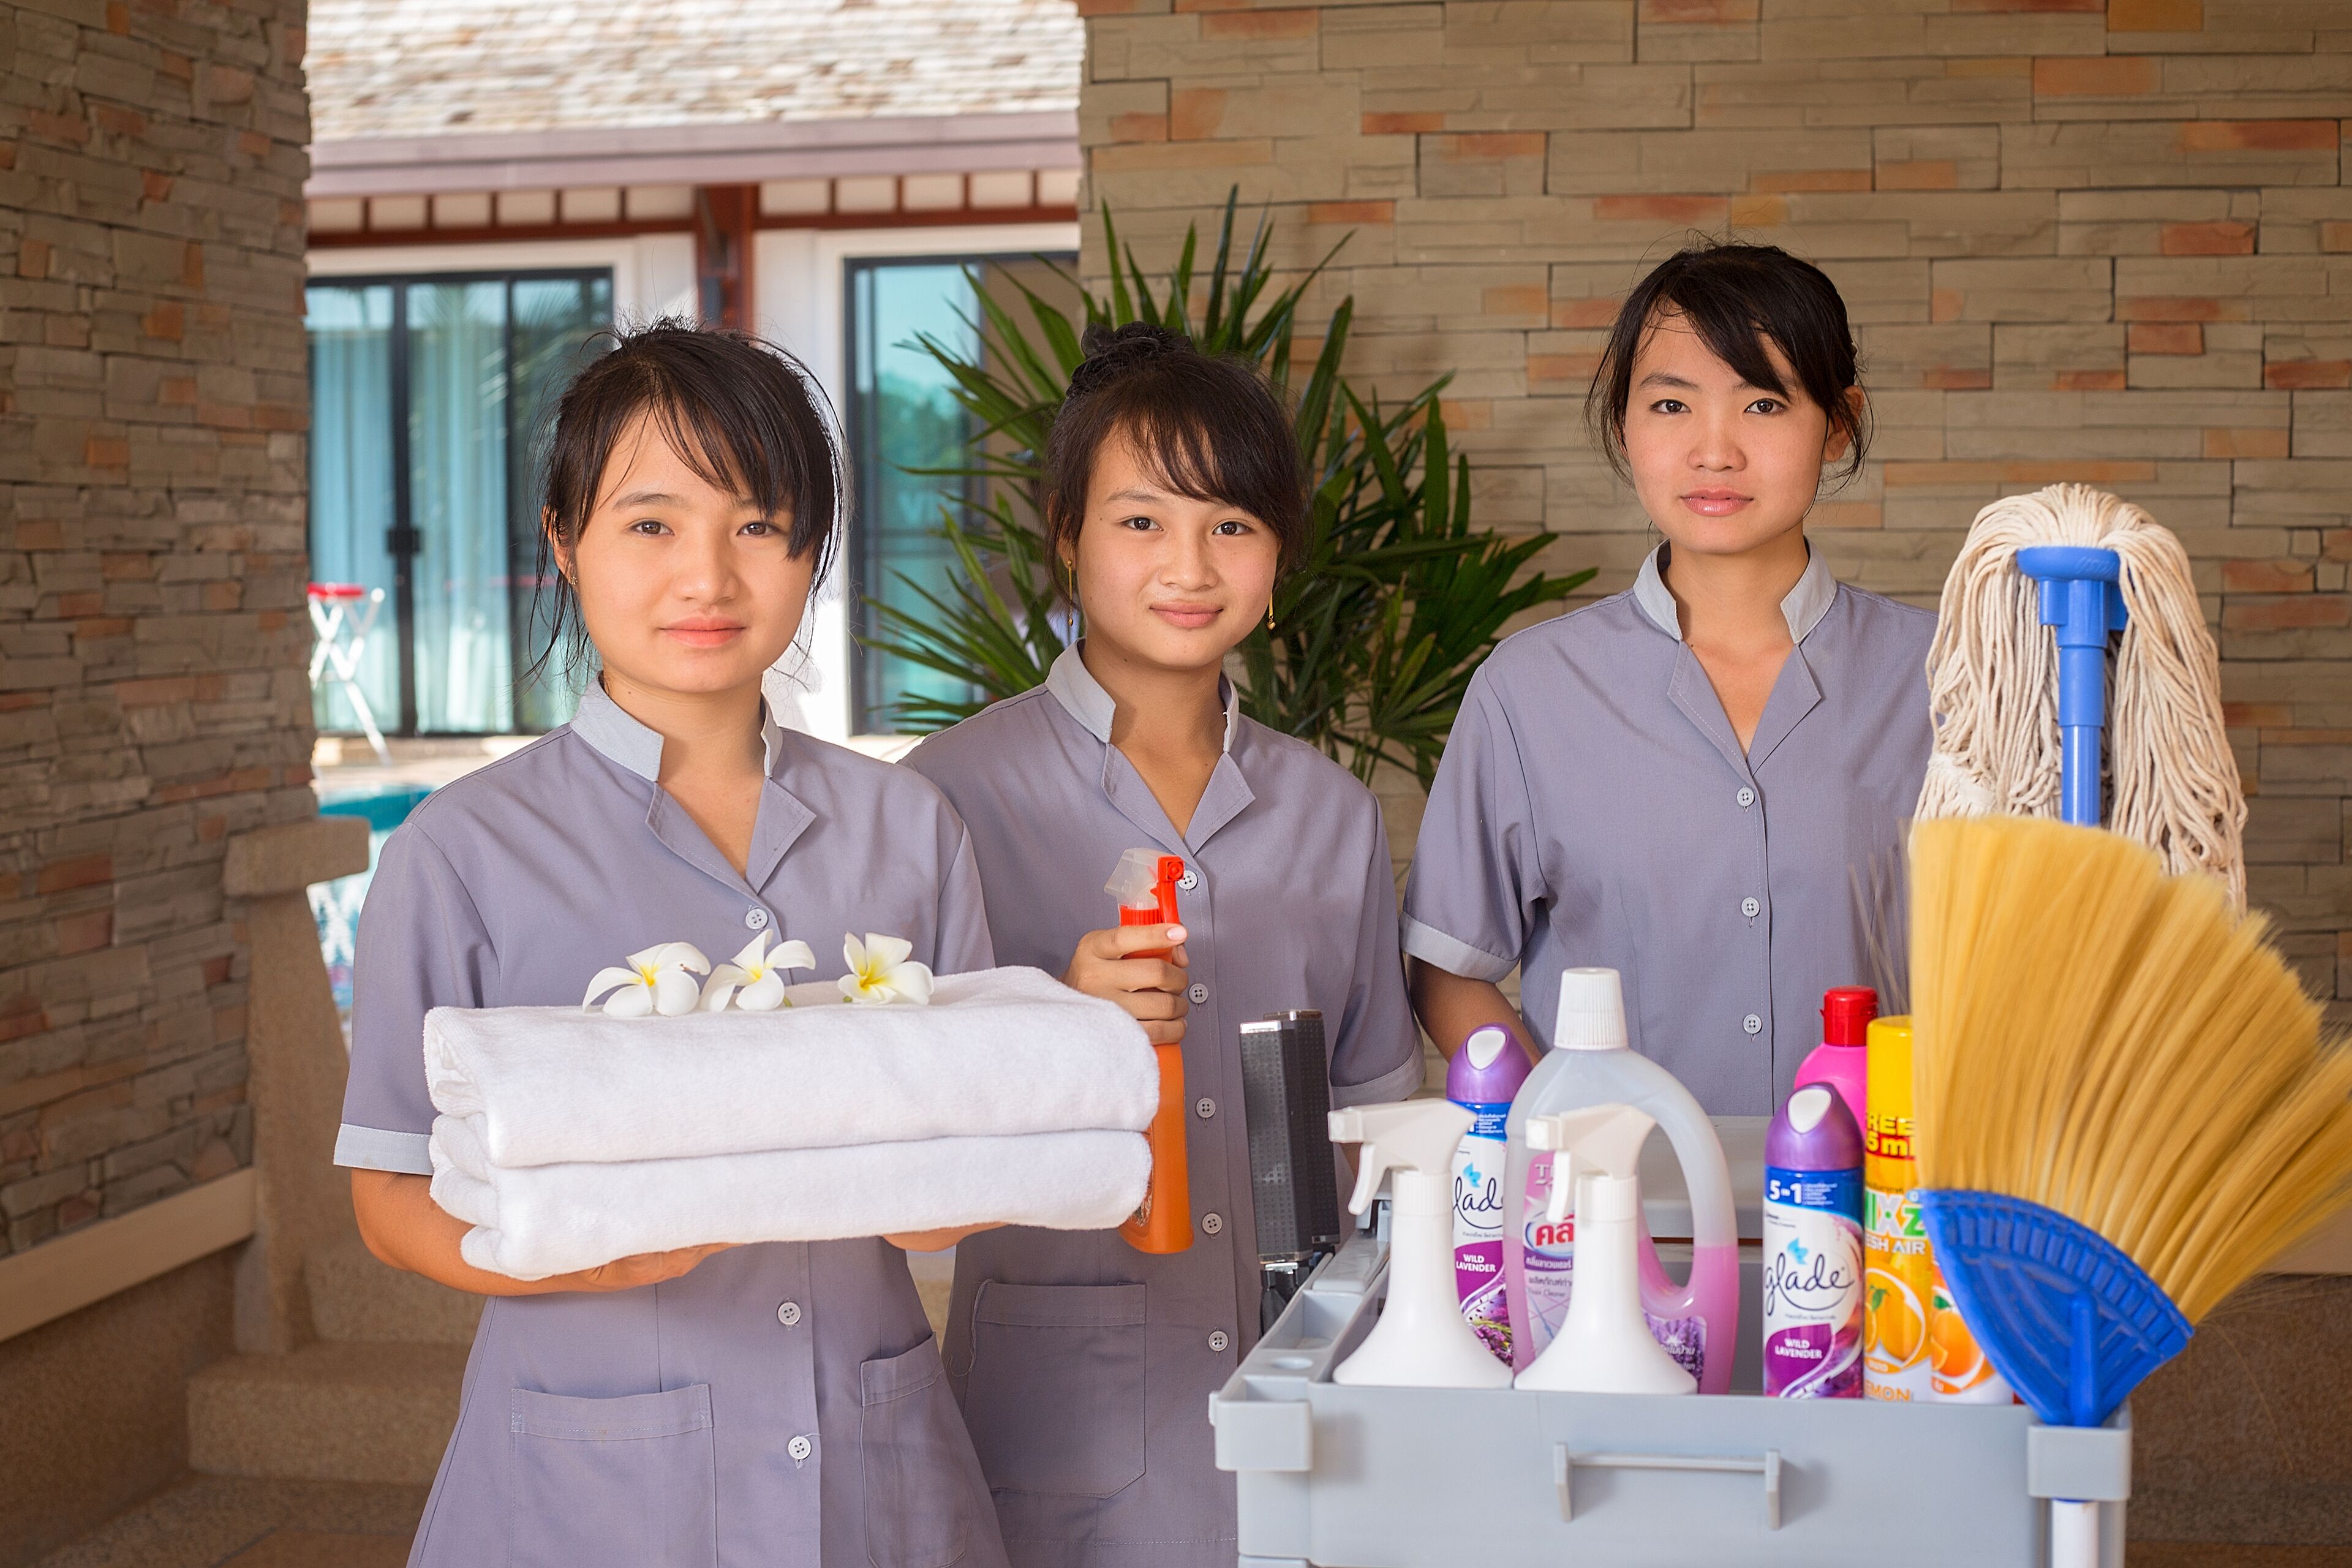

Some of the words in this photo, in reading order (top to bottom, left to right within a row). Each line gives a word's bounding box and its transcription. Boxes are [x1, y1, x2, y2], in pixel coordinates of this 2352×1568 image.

[1866, 1113, 1915, 1136] REE
[1453, 1176, 1503, 1229] lad
[1891, 1240, 1926, 1255] AIR
[1463, 1254, 1485, 1263] WILD
[1456, 1261, 1496, 1273] LAVENDER
[1766, 1252, 1855, 1316] glade
[1784, 1338, 1810, 1349] WILD
[1774, 1345, 1822, 1359] LAVENDER
[1864, 1379, 1911, 1402] EMON
